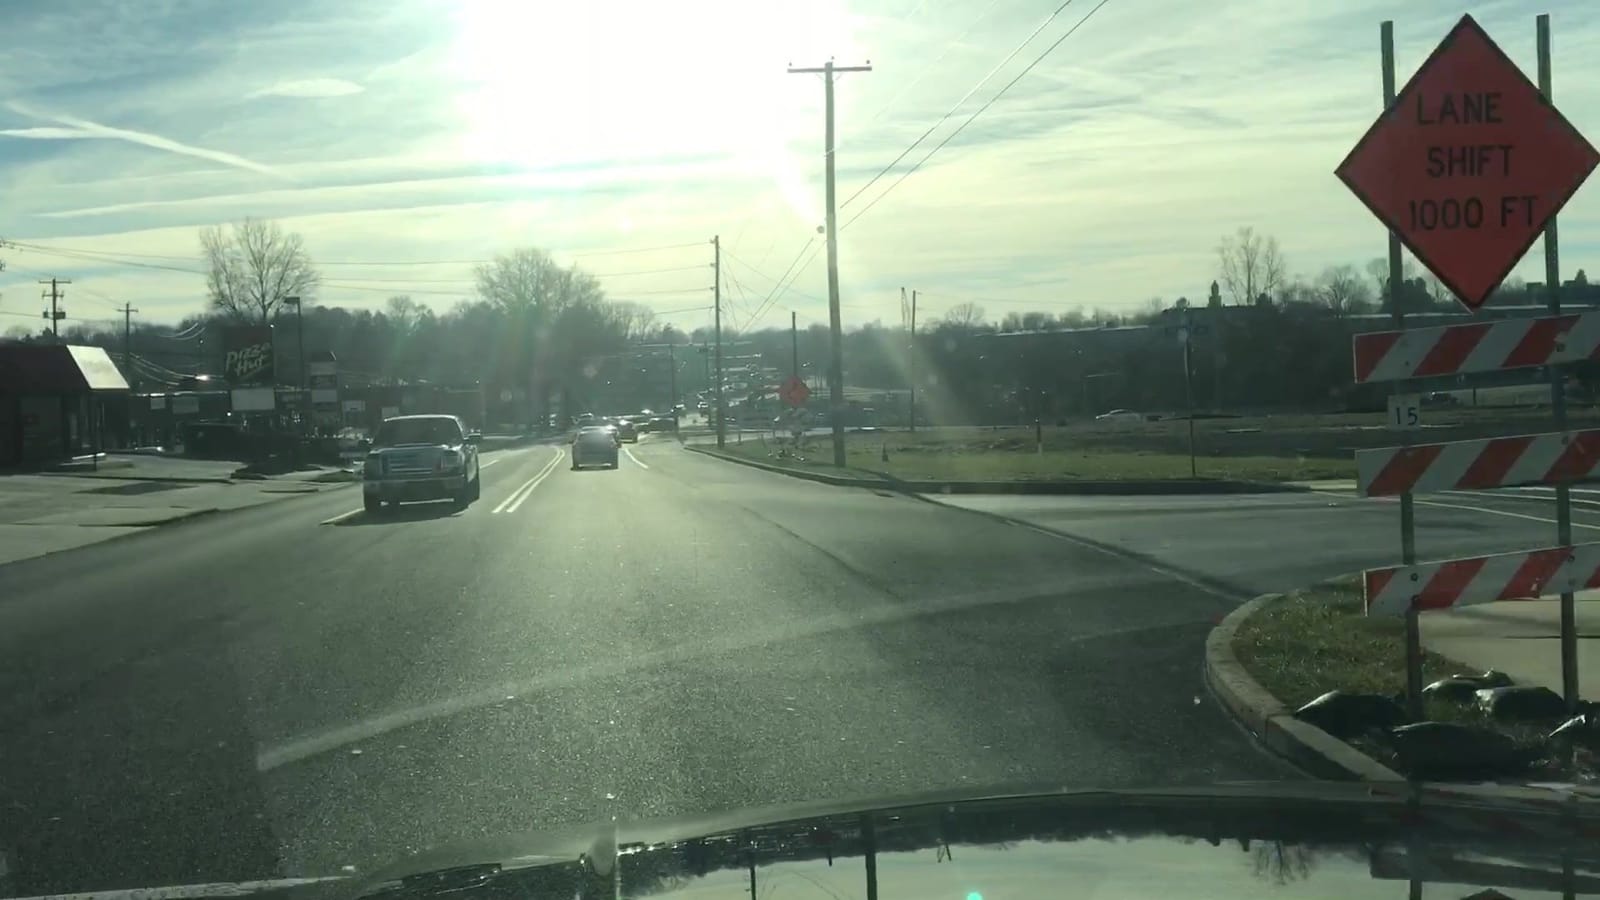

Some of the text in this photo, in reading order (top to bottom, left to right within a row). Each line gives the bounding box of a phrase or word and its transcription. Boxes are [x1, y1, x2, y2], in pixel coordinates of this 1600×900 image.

[1417, 92, 1503, 125] LANE
[1426, 145, 1514, 178] SHIFT
[1409, 195, 1538, 231] 1000 FT
[1396, 406, 1418, 426] 15
